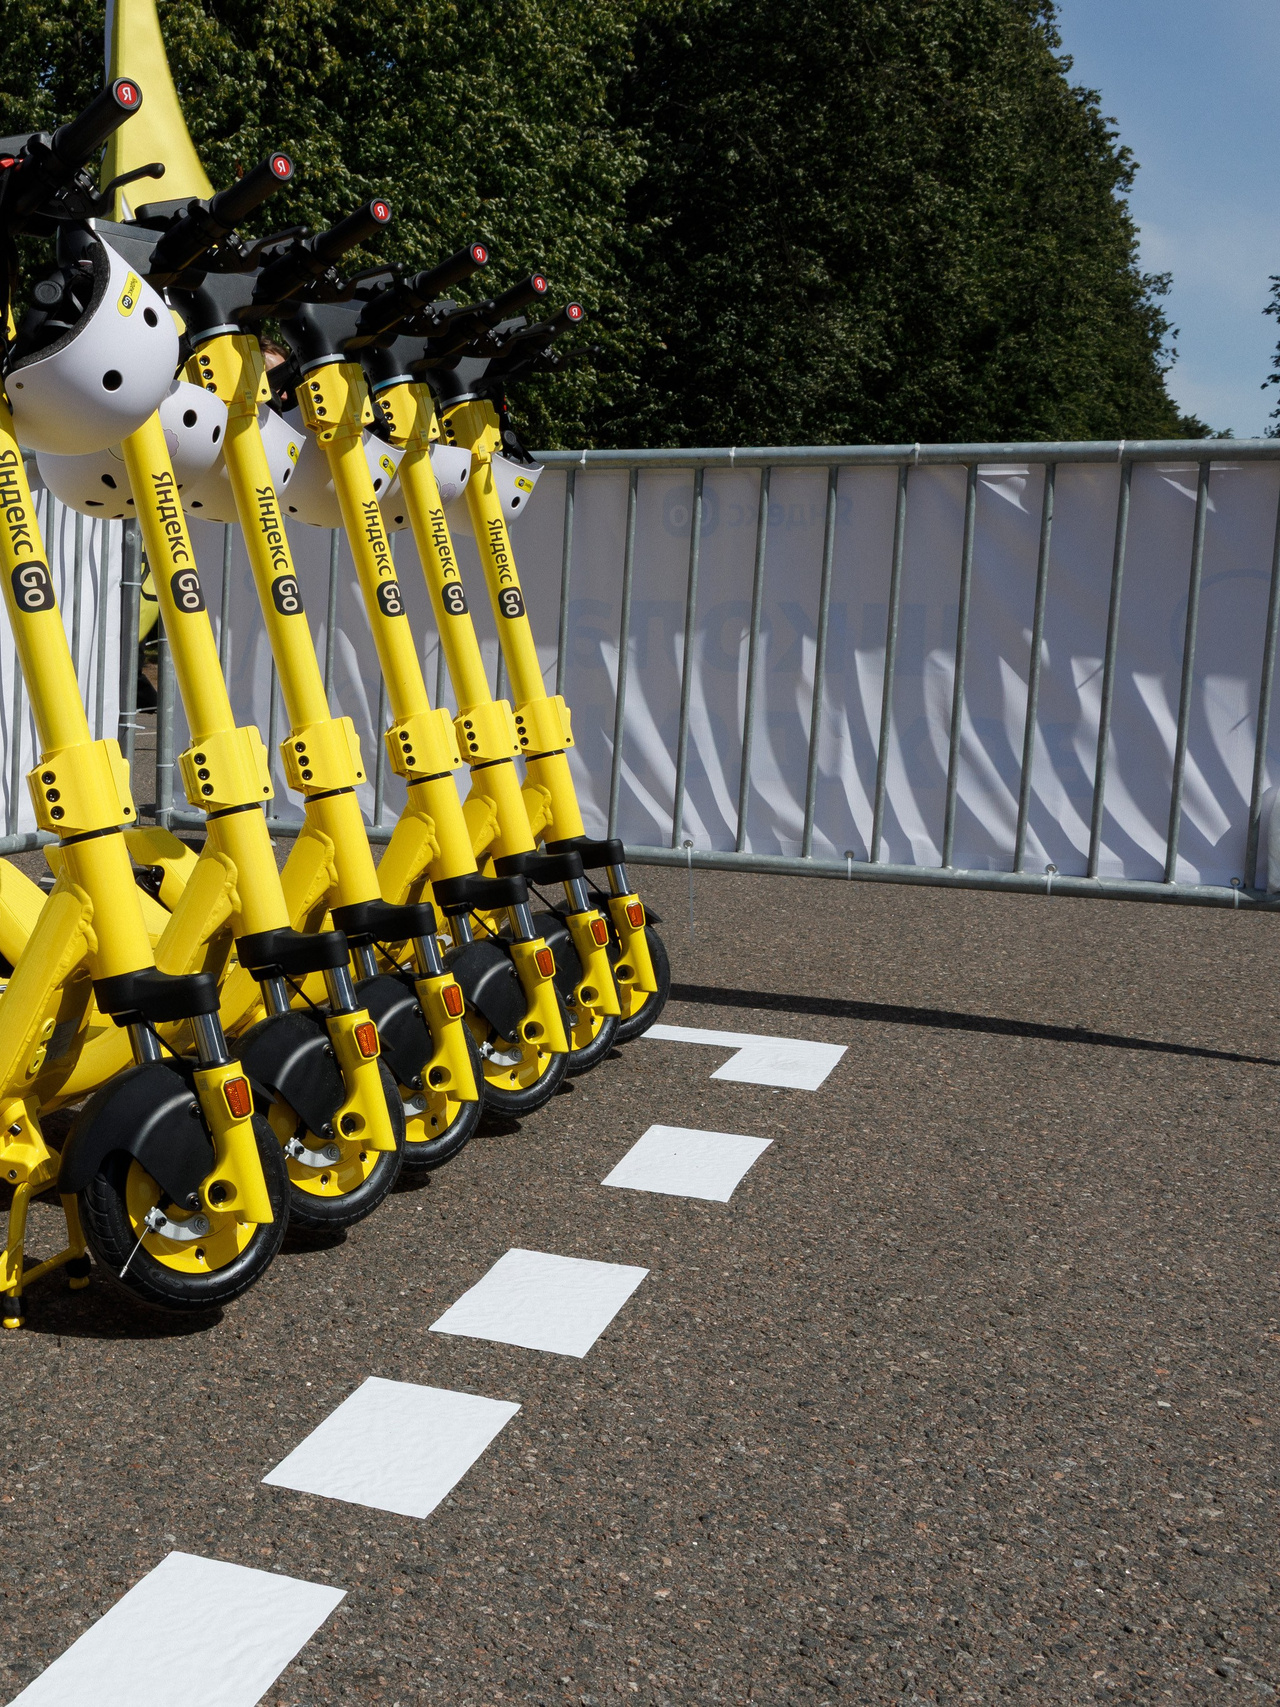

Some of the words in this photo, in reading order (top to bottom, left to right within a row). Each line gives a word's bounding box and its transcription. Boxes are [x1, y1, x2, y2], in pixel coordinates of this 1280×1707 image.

[122, 87, 132, 101] Я
[277, 161, 286, 173] Я
[377, 205, 385, 216] Я
[19, 566, 46, 607] Go
[151, 471, 189, 564] Яндекс
[178, 573, 200, 609] Go
[255, 486, 288, 570] Яндекс
[278, 579, 299, 611] Go
[362, 500, 392, 576] Яндекс
[383, 584, 401, 613] Go
[428, 508, 456, 578] Яндекс
[447, 585, 464, 612] Go
[487, 518, 512, 584] Яндекс
[503, 590, 520, 616] Go
